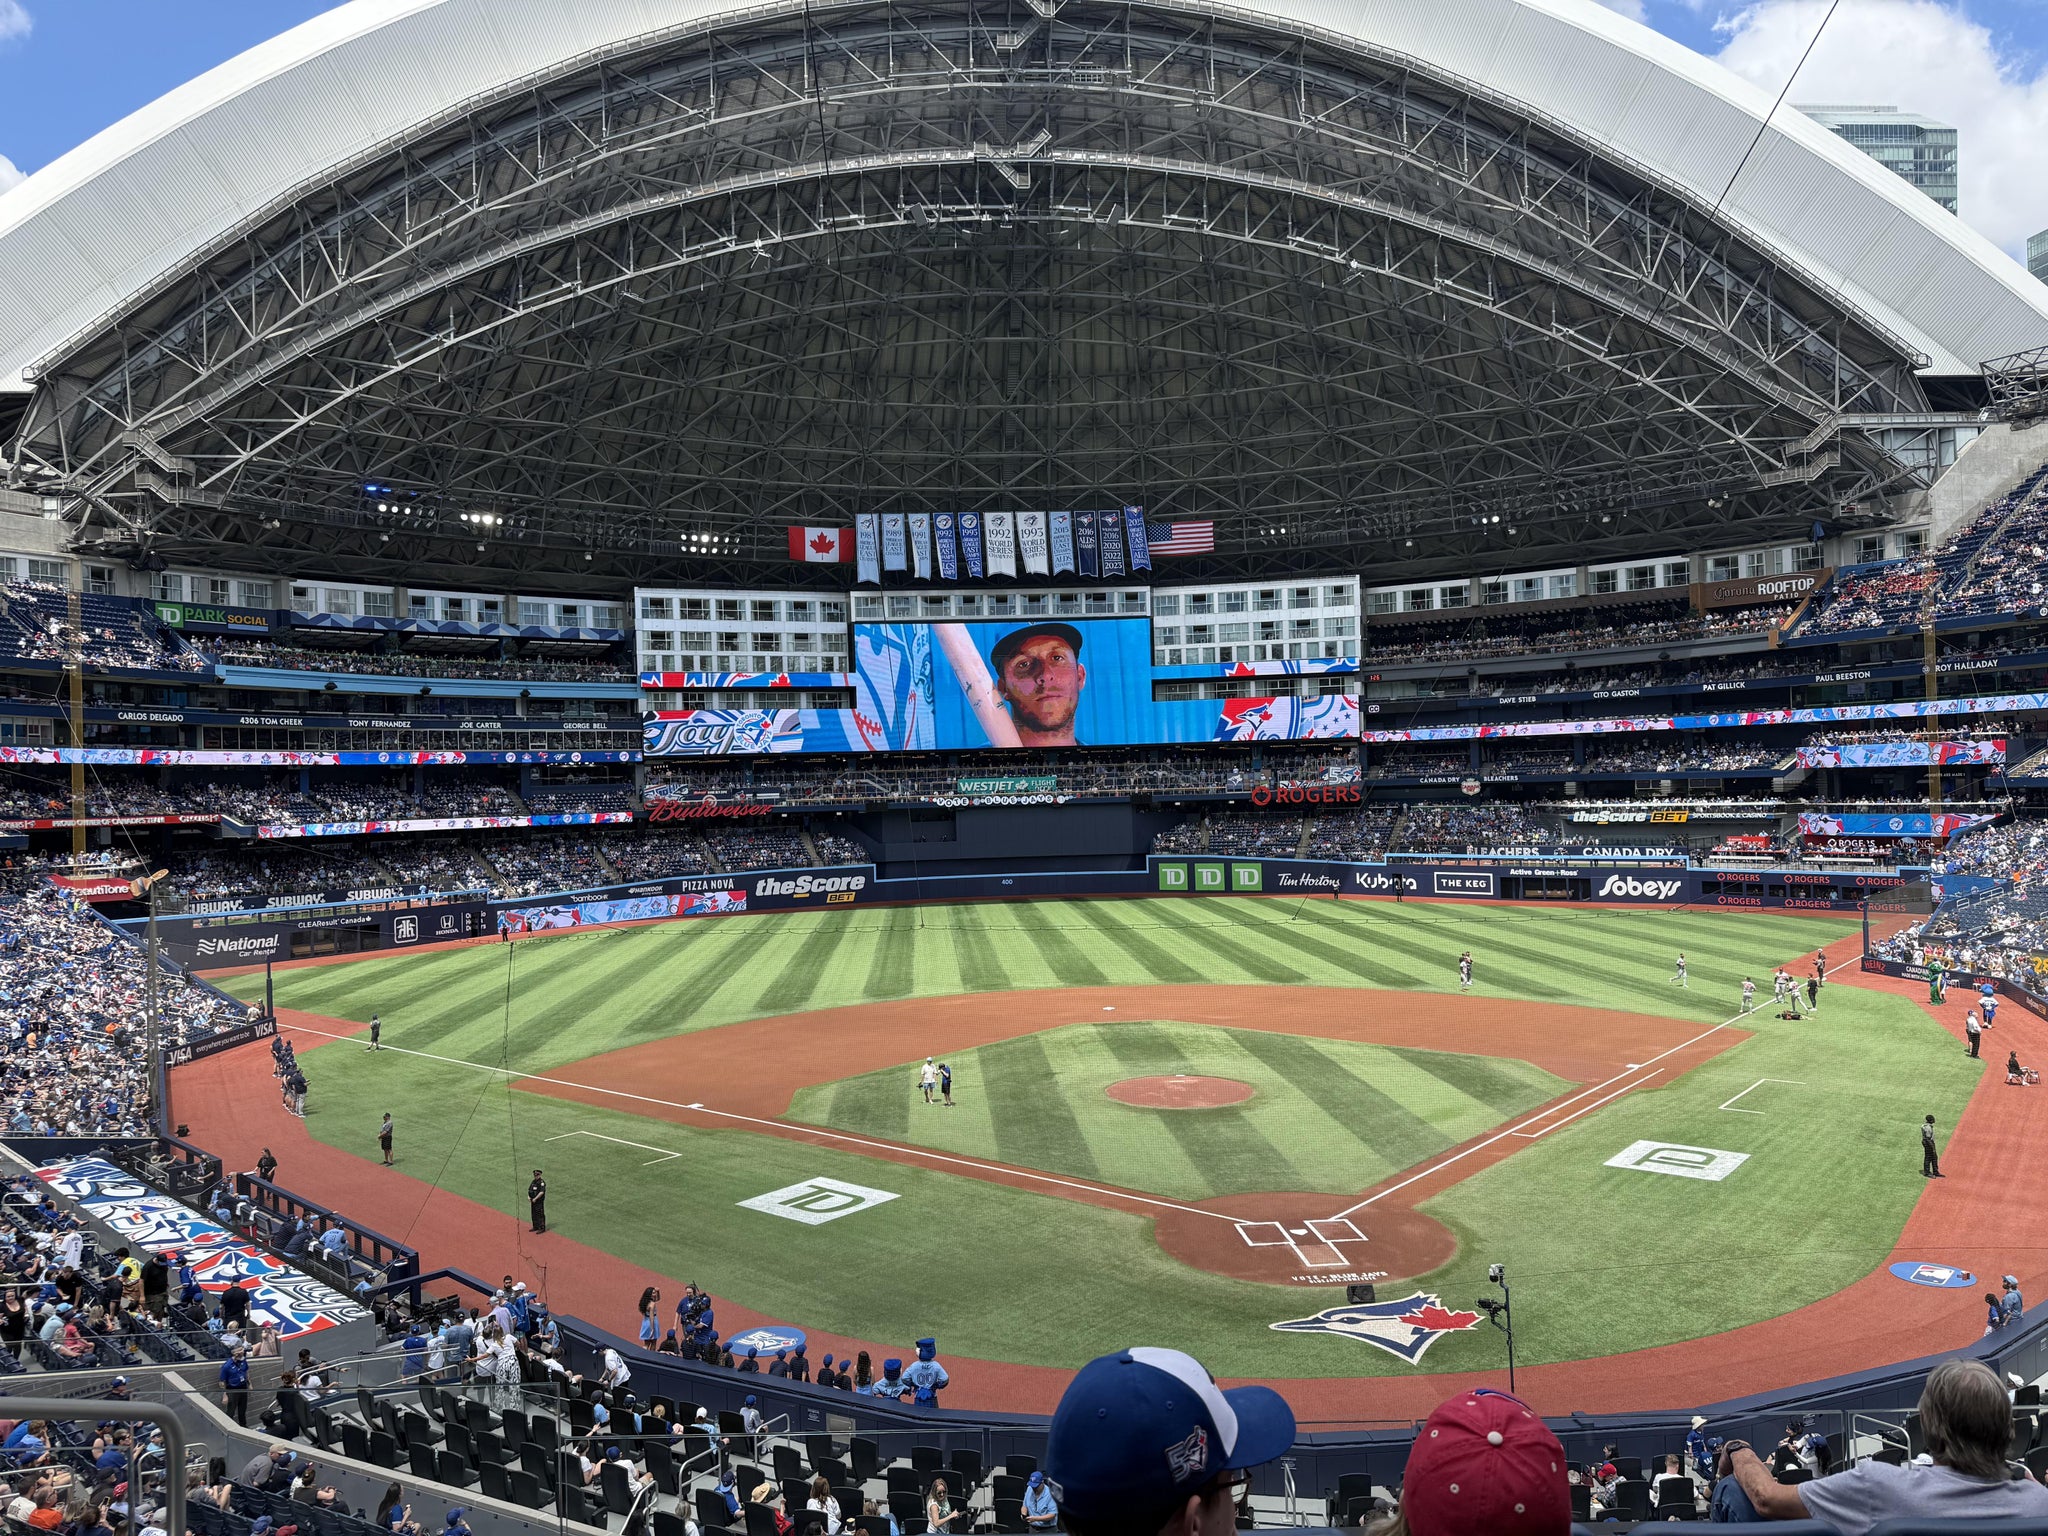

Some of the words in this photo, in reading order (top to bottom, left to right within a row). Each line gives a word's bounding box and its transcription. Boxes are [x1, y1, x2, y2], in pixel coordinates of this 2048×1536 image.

[936, 529, 953, 537] 1992
[988, 528, 1011, 539] 1992
[1020, 527, 1044, 539] 1993
[1053, 526, 1069, 534] 2015
[1077, 527, 1094, 536] 2016
[1102, 531, 1120, 539] 2016
[988, 539, 1013, 547] WORLD
[1022, 538, 1045, 547] WORLD
[1079, 536, 1095, 544] ALDS
[988, 546, 1013, 554] SERIES
[1103, 542, 1121, 550] 2020
[1056, 555, 1073, 563] ALDS
[1104, 552, 1122, 560] 2022
[1104, 562, 1123, 570] 2023
[1757, 578, 1815, 596] ROOFTOP
[1713, 587, 1756, 600] Corona
[1773, 592, 1799, 600] PATIO
[158, 607, 181, 625] TD
[184, 607, 226, 623] PARK
[227, 614, 269, 626] SOCIAL
[1934, 663, 1952, 672] ROY
[1954, 659, 1999, 671] HALLADAY
[1815, 674, 1834, 683] PAUL
[1835, 671, 1871, 681] BEESTON
[1702, 683, 1716, 691] PAT
[1717, 681, 1746, 690] GILLICK
[1593, 691, 1609, 699] CITO
[1611, 689, 1640, 698] GASTON
[1518, 695, 1537, 704] STIEB
[117, 711, 148, 721] CARLOS
[149, 712, 184, 722] DELGADO
[736, 713, 762, 730] TORONTO
[239, 717, 259, 725] 4306
[260, 717, 278, 726] TOM
[279, 718, 304, 727] CHEEK
[348, 719, 369, 728] TONY
[371, 720, 411, 729] FERNANDEZ
[459, 721, 475, 729] JOE
[476, 721, 502, 730] CARTER
[562, 722, 590, 730] GEORGE
[592, 722, 608, 730] BELL
[959, 780, 1014, 793] WESTJET
[1031, 779, 1056, 787] FLIGHT
[1276, 785, 1361, 803] ROGERS
[937, 797, 969, 807] VOTE
[985, 796, 1018, 805] BLUE
[1021, 794, 1053, 805] JAYS
[644, 798, 774, 822] Budweiser
[1573, 811, 1647, 824] theScore
[1651, 812, 1687, 822] BET
[1583, 847, 1643, 857] CANADA
[1646, 848, 1675, 857] DRY
[1162, 868, 1185, 885] TD
[1197, 868, 1221, 885] TD
[1234, 868, 1259, 885] TD
[1510, 868, 1533, 877] Active
[1727, 873, 1761, 882] ROGERS
[682, 879, 708, 892] PIZZA
[710, 878, 734, 890] NOVA
[1278, 873, 1298, 887] Tim
[1299, 872, 1340, 888] Hortons
[1441, 879, 1462, 888] THE
[1465, 879, 1487, 888] KEG
[1794, 875, 1831, 885] ROGERS
[1867, 877, 1906, 887] ROGERS
[756, 875, 866, 897] theScore
[1599, 874, 1682, 900] Sobeys
[266, 893, 325, 908] SUBWAY
[828, 893, 855, 902] BET
[1727, 896, 1761, 906] ROGERS
[1795, 899, 1831, 909] ROGERS
[1868, 902, 1907, 912] ROGERS
[298, 919, 338, 929] CLEAResult
[340, 916, 366, 926] Canada
[436, 927, 459, 936] HONDA
[216, 933, 280, 953] National
[239, 950, 252, 958] Car
[253, 947, 276, 957] Rental
[1865, 960, 1887, 972] HEINZ
[1901, 971, 1911, 979] MADE
[1973, 977, 2000, 990] HEINZ
[254, 1022, 274, 1038] VISA
[195, 1040, 222, 1053] everywhere
[221, 1037, 230, 1046] you
[229, 1034, 240, 1043] want
[240, 1032, 245, 1040] to
[168, 1046, 193, 1064] VISA
[777, 1184, 866, 1214] TD
[1290, 1274, 1318, 1282] VOTE
